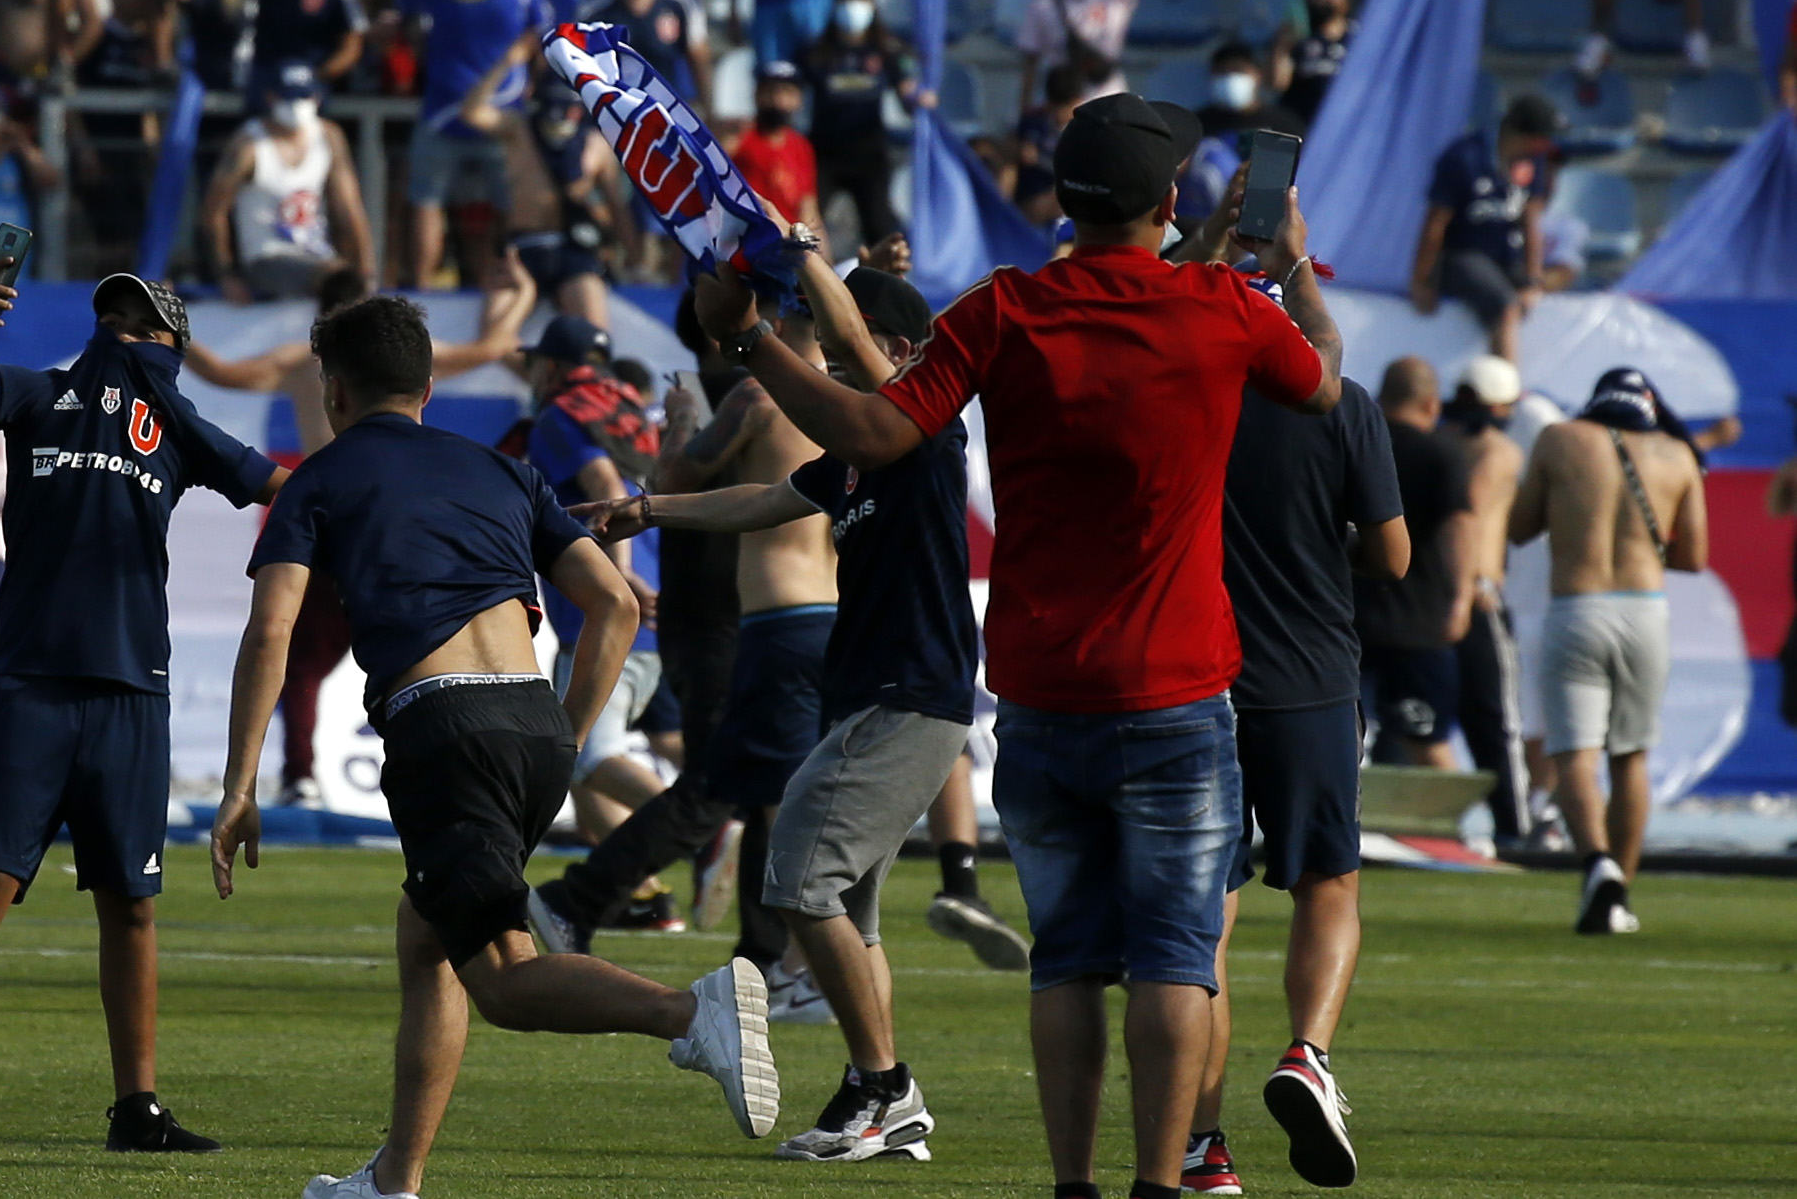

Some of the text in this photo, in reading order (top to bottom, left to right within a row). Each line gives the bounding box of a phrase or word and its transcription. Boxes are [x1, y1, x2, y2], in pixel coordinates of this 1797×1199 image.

[53, 402, 84, 410] adidas
[128, 397, 162, 456] U
[55, 452, 163, 494] PETROBAS
